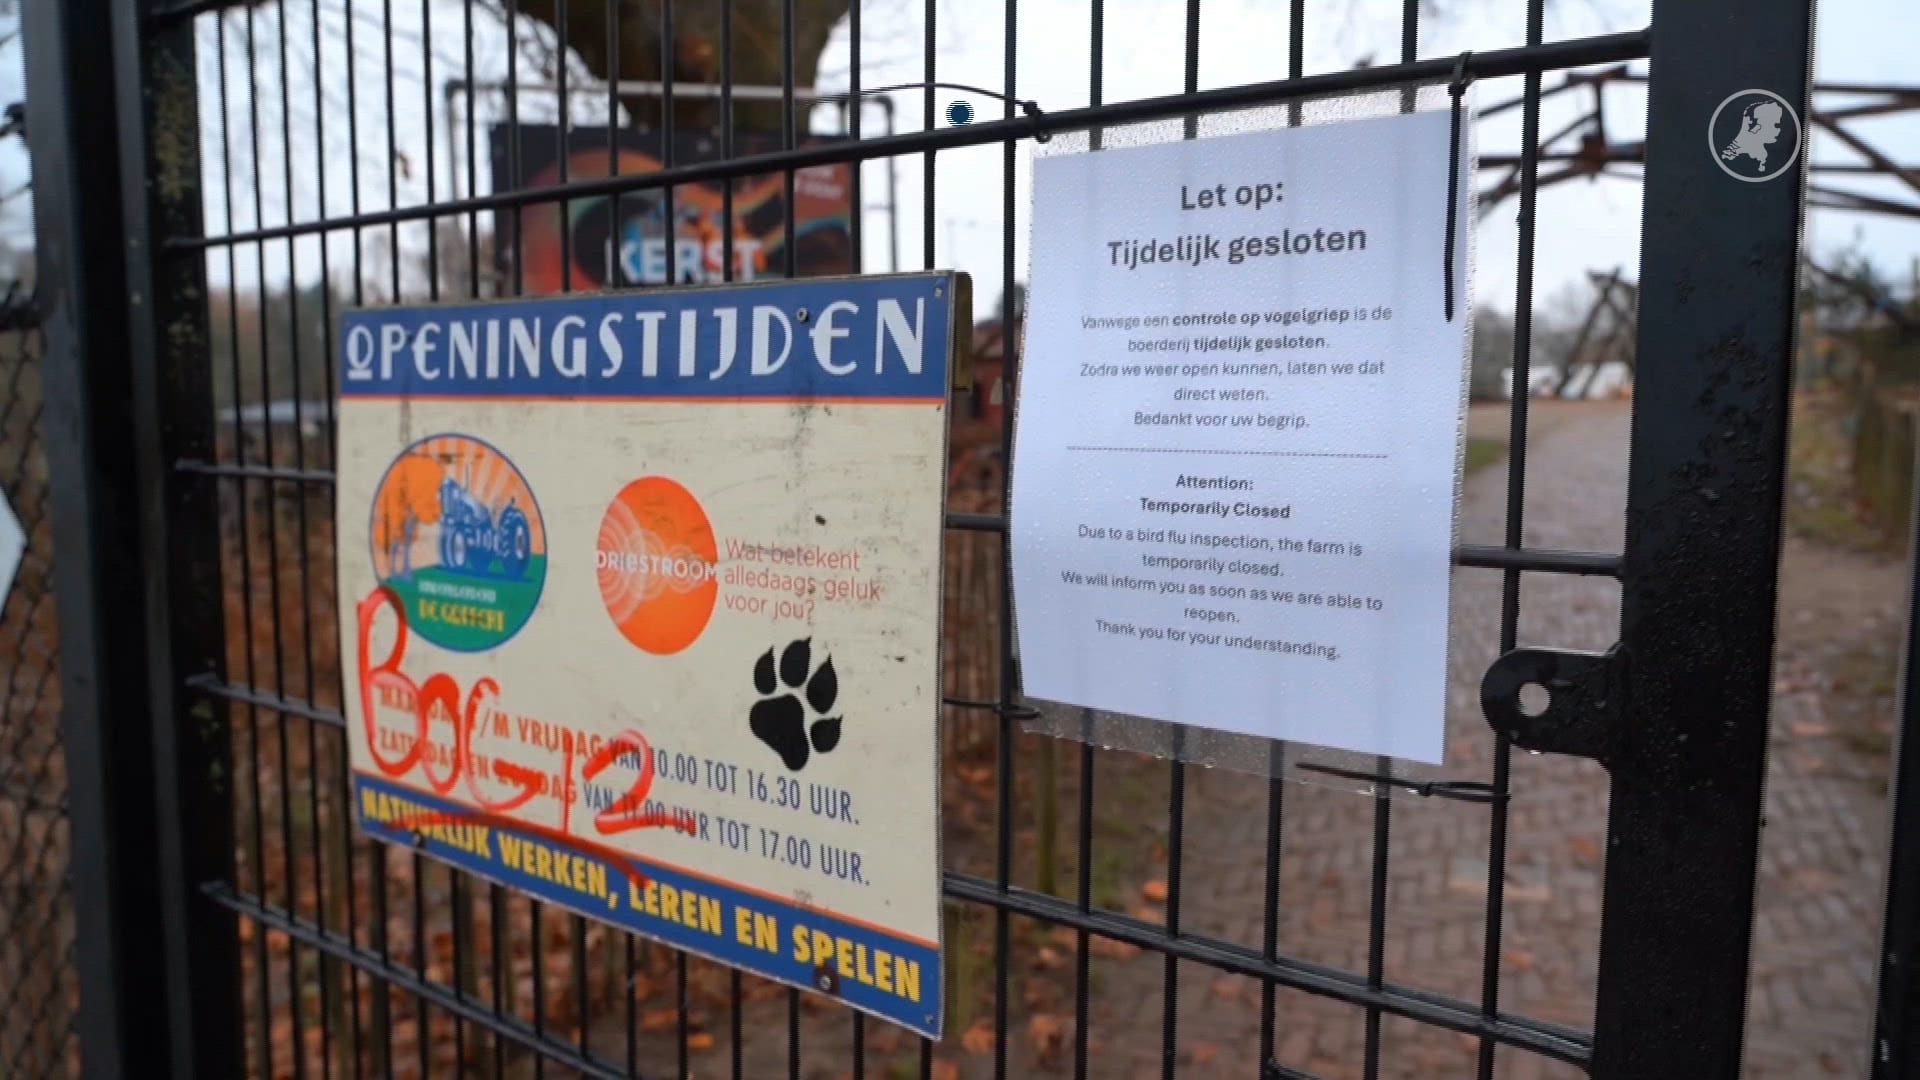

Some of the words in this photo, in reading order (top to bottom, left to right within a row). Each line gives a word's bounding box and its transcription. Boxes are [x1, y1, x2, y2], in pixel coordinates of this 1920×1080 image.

[1181, 184, 1227, 211] Let
[1234, 180, 1284, 211] op:
[1107, 234, 1219, 271] Tijdelijk
[1227, 227, 1367, 265] gesloten
[1080, 314, 1140, 331] Vanwege
[1143, 315, 1169, 328] een
[1172, 311, 1237, 328] controle
[1240, 311, 1260, 328] op
[1263, 307, 1350, 327] vogelgriep
[1353, 306, 1367, 320] is
[1370, 305, 1393, 321] de
[346, 297, 925, 381] OPENINGSTIJDEN
[1127, 338, 1190, 354] boerderij
[1193, 335, 1251, 353] tijdelijk
[1254, 335, 1330, 353] gesloten.
[1079, 362, 1118, 377] Zodra
[1121, 365, 1141, 377] we
[1144, 364, 1179, 377] weer
[1181, 363, 1218, 379] open
[1222, 361, 1283, 378] kunnen,
[1287, 361, 1327, 375] laten
[1331, 362, 1353, 375] we
[1357, 359, 1385, 375] dat
[1173, 387, 1215, 401] direct
[1218, 388, 1270, 402] weten.
[1133, 411, 1192, 426] Bedankt
[1195, 414, 1227, 426] voor
[1231, 415, 1254, 427] uw
[1256, 413, 1311, 430] begrip.
[1175, 473, 1255, 491] Attention:
[1139, 497, 1230, 518] Temporarily
[1232, 501, 1292, 519] Closed
[725, 538, 765, 562] Wat
[770, 543, 861, 573] betekent
[1078, 523, 1106, 540] Due
[1108, 526, 1123, 541] to
[1125, 530, 1134, 541] a
[1137, 528, 1164, 543] bird
[1167, 530, 1187, 545] flu
[1189, 532, 1275, 552] inspection,
[1277, 536, 1303, 553] the
[1307, 538, 1345, 555] farm
[1348, 541, 1363, 557] is
[1142, 553, 1225, 575] temporarily
[1227, 559, 1285, 577] closed.
[724, 565, 817, 597] alledaags
[823, 578, 882, 601] geluk
[1060, 570, 1083, 585] We
[1085, 572, 1108, 587] will
[1111, 574, 1156, 591] inform
[1158, 580, 1185, 594] you
[1188, 583, 1206, 596] as
[1209, 584, 1246, 600] soon
[1249, 588, 1268, 602] as
[1270, 590, 1294, 603] we
[1297, 591, 1324, 606] are
[1326, 593, 1363, 610] able
[1365, 596, 1384, 611] to
[724, 593, 769, 613] voor
[771, 598, 816, 622] jou?
[1183, 606, 1241, 625] reopen.
[1095, 619, 1136, 636] Thank
[1139, 626, 1164, 641] you
[1166, 627, 1186, 642] for
[1189, 631, 1221, 647] your
[1223, 634, 1340, 661] understanding.
[704, 758, 738, 796] TOT
[747, 769, 801, 811] 16.30
[809, 782, 860, 826] UUR.
[582, 782, 614, 813] VAN
[715, 815, 751, 852] TOT
[759, 827, 812, 870] 17.00
[819, 843, 871, 888] UUR.
[496, 830, 618, 910] WERKEN,
[629, 878, 723, 937] LEREN
[735, 905, 779, 955] EN
[792, 923, 921, 1004] SPELEN
